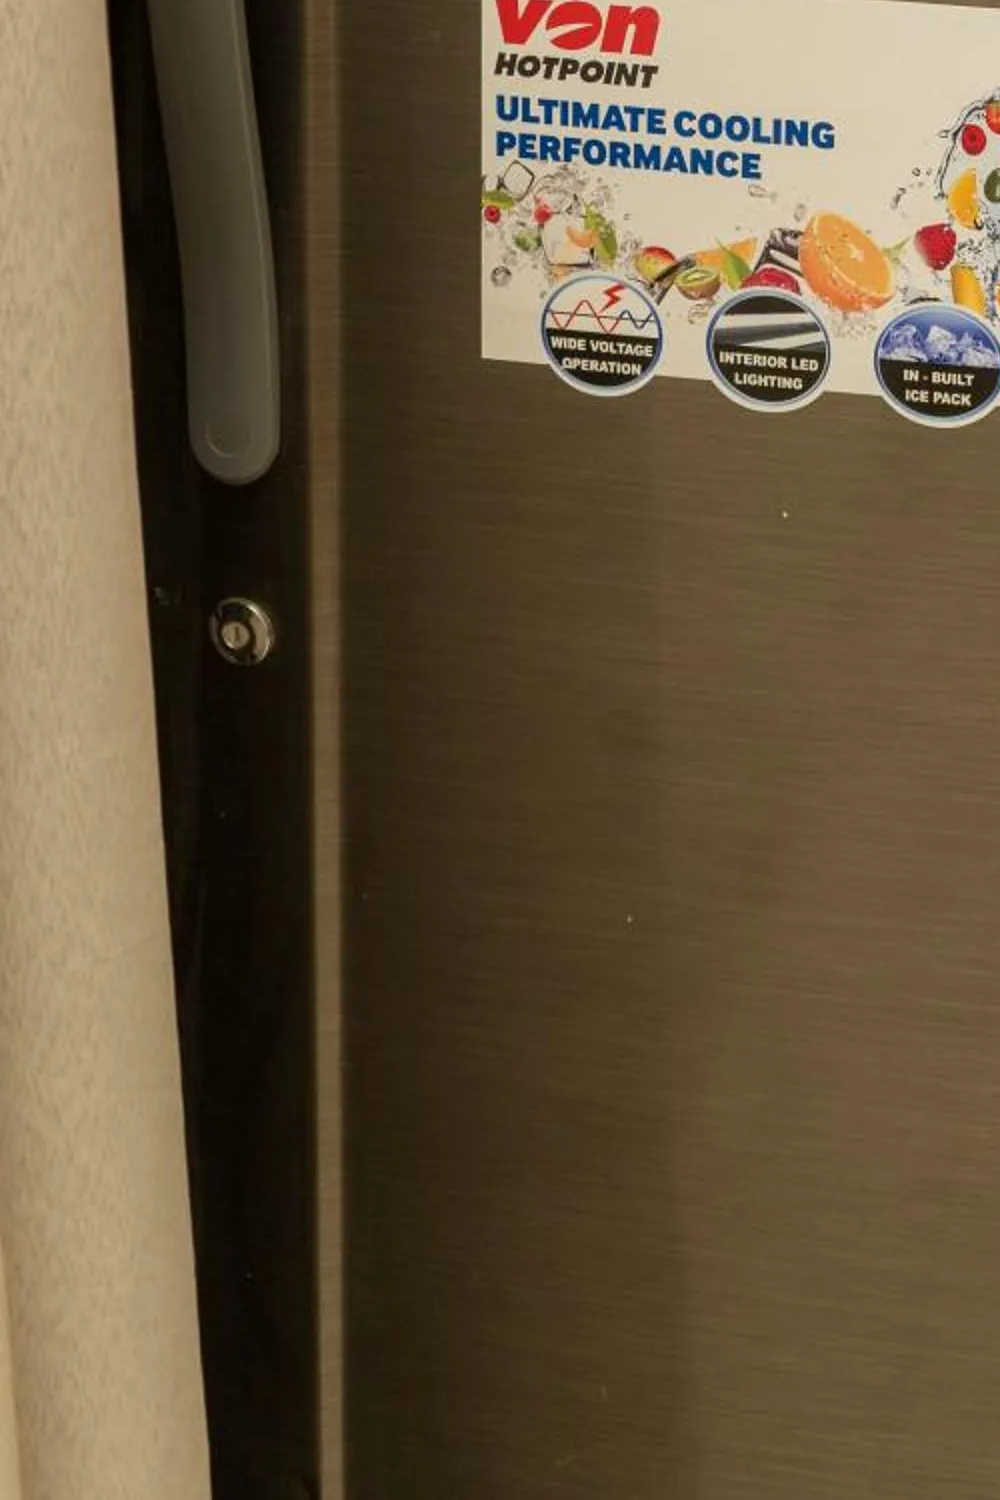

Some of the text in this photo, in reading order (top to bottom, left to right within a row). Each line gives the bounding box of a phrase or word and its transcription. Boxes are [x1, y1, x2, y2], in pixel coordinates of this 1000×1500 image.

[494, 51, 659, 89] HOTPOINT
[496, 95, 836, 150] ULTIMATE COOLING
[495, 131, 762, 179] PERFORMANCE
[550, 334, 654, 358] WIDE VOLTAGE
[560, 356, 642, 377] OPERATION
[719, 350, 820, 372] INTERIOR LED
[733, 371, 804, 391] LIGHTING
[902, 368, 918, 383] IN
[931, 371, 975, 387] BUILT
[904, 389, 973, 407] ICE PACK
